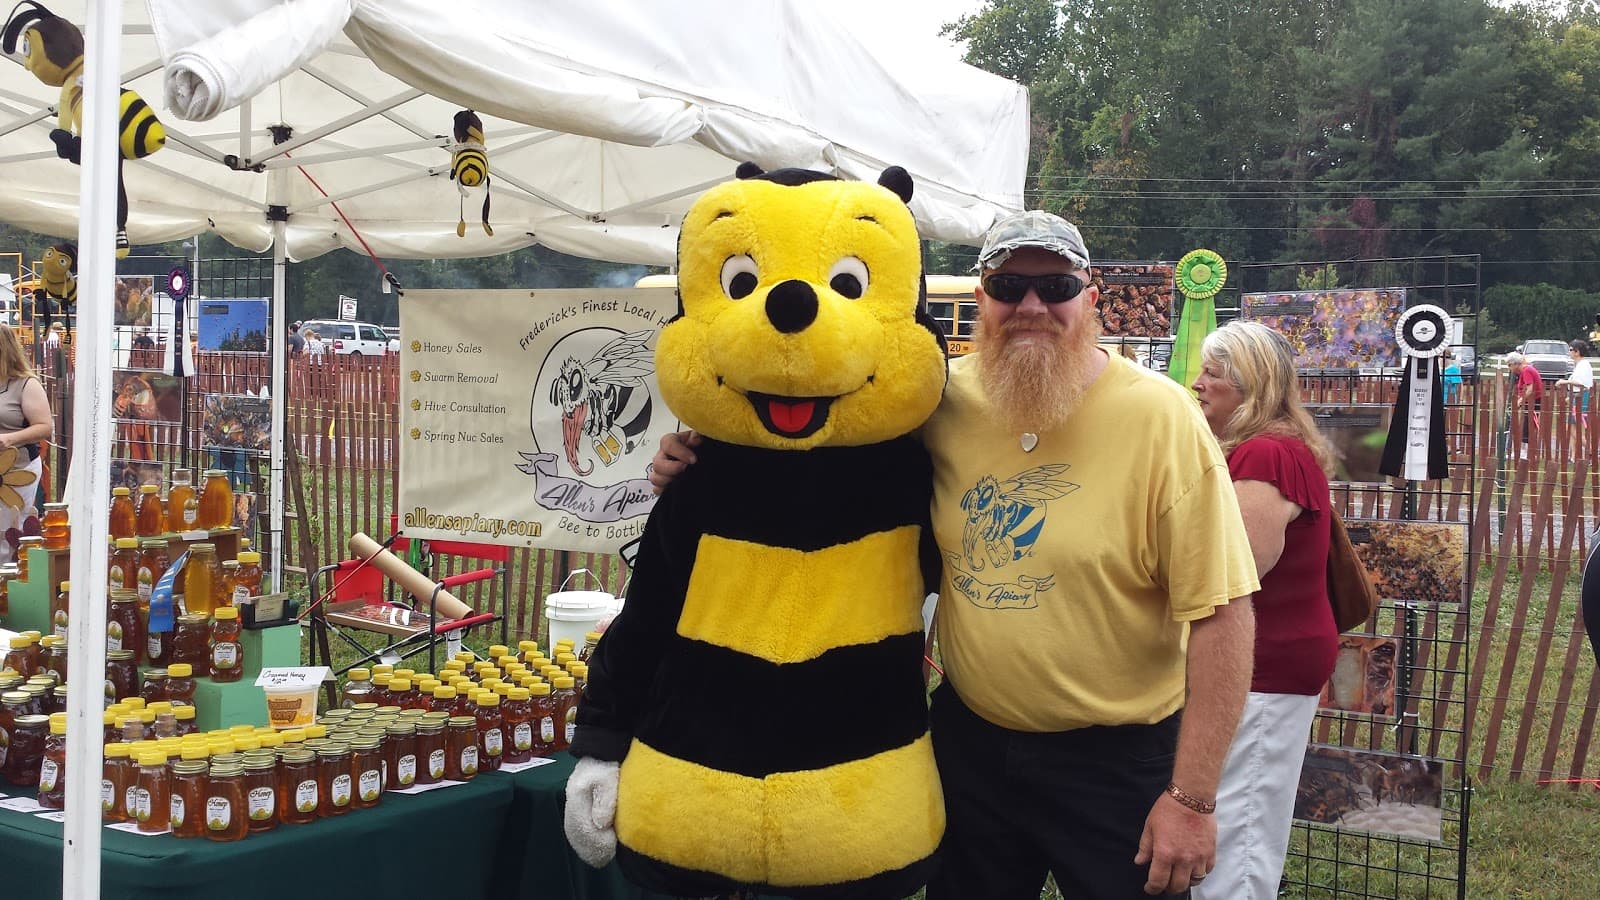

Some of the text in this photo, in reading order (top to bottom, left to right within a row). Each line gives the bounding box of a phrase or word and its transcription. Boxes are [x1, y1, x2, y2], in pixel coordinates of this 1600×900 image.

[519, 306, 577, 351] Frederick's
[582, 299, 619, 313] Finest
[624, 301, 657, 321] Local
[423, 342, 482, 354] Honey Sales
[949, 343, 961, 352] 20
[424, 371, 499, 384] Swarm Removal
[424, 401, 506, 414] Hive Consultation
[424, 430, 504, 443] Spring Nuc Sales
[541, 483, 657, 515] Allen's Apiar
[404, 507, 542, 538] allensapiary.com
[558, 516, 581, 532] Bee
[586, 526, 600, 537] to
[953, 575, 1032, 606] Allen's Apiary
[290, 671, 306, 681] Honey
[249, 790, 272, 799] Honey
[208, 799, 228, 809] Honey
